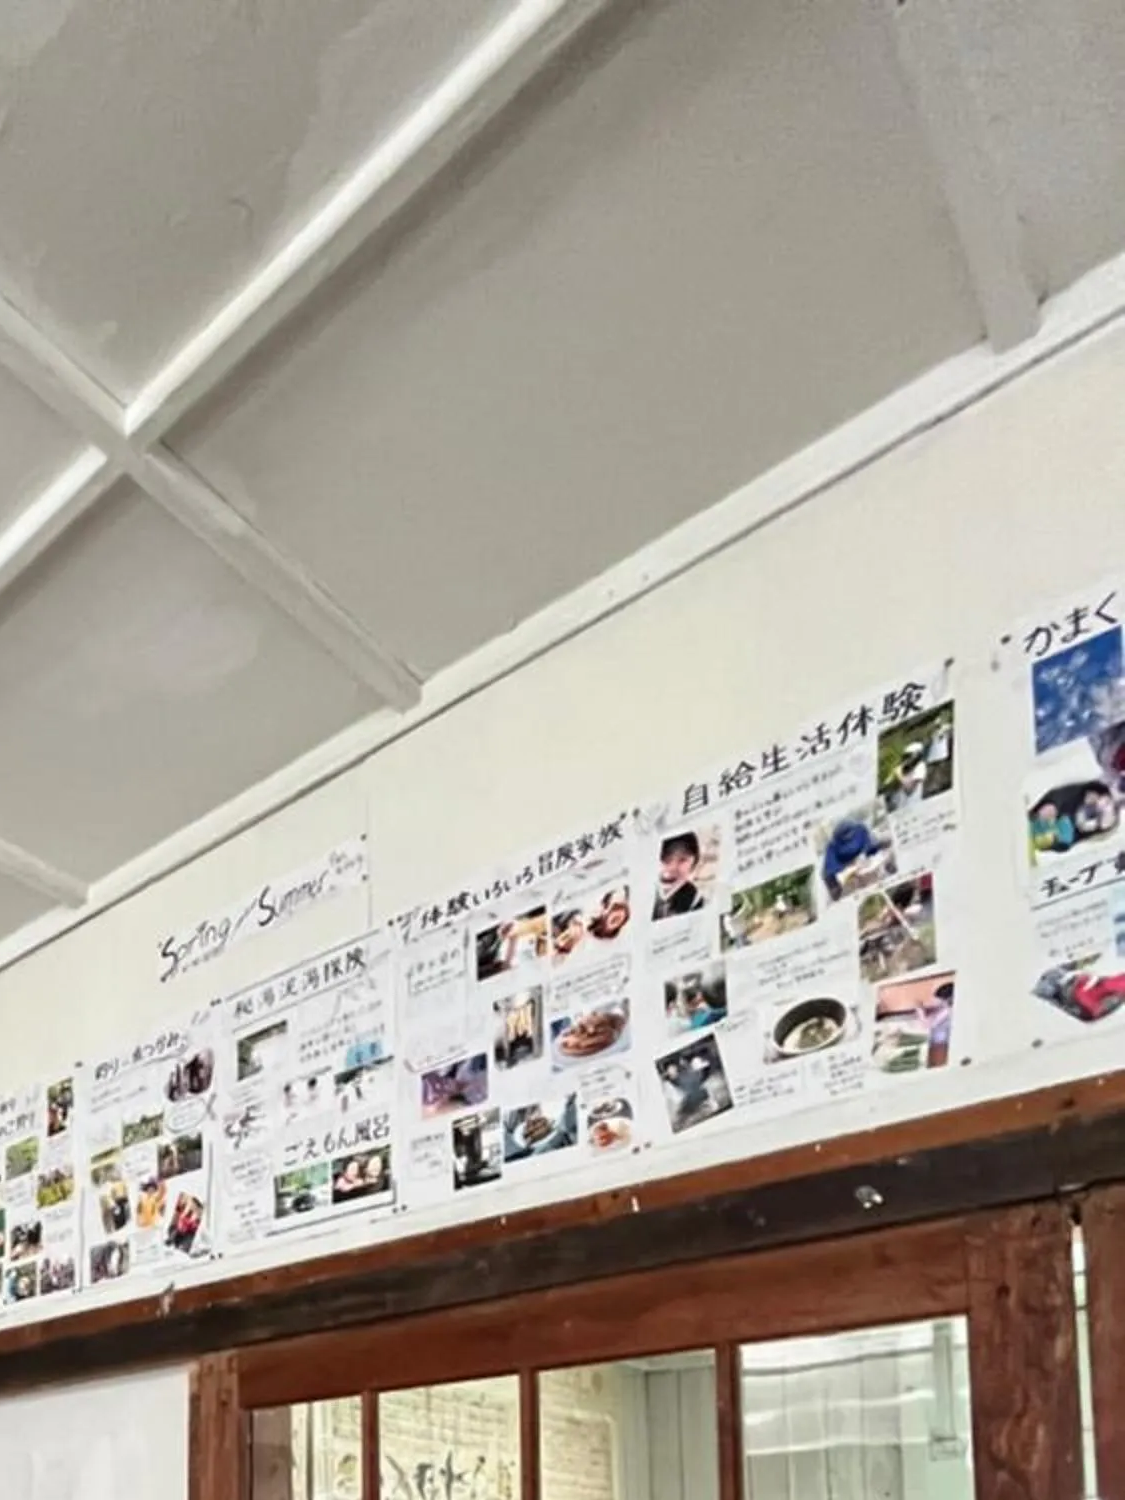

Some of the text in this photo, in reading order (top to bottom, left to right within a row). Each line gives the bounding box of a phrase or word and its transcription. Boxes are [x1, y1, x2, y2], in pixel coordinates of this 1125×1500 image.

[681, 681, 927, 816] 自給生活体験
